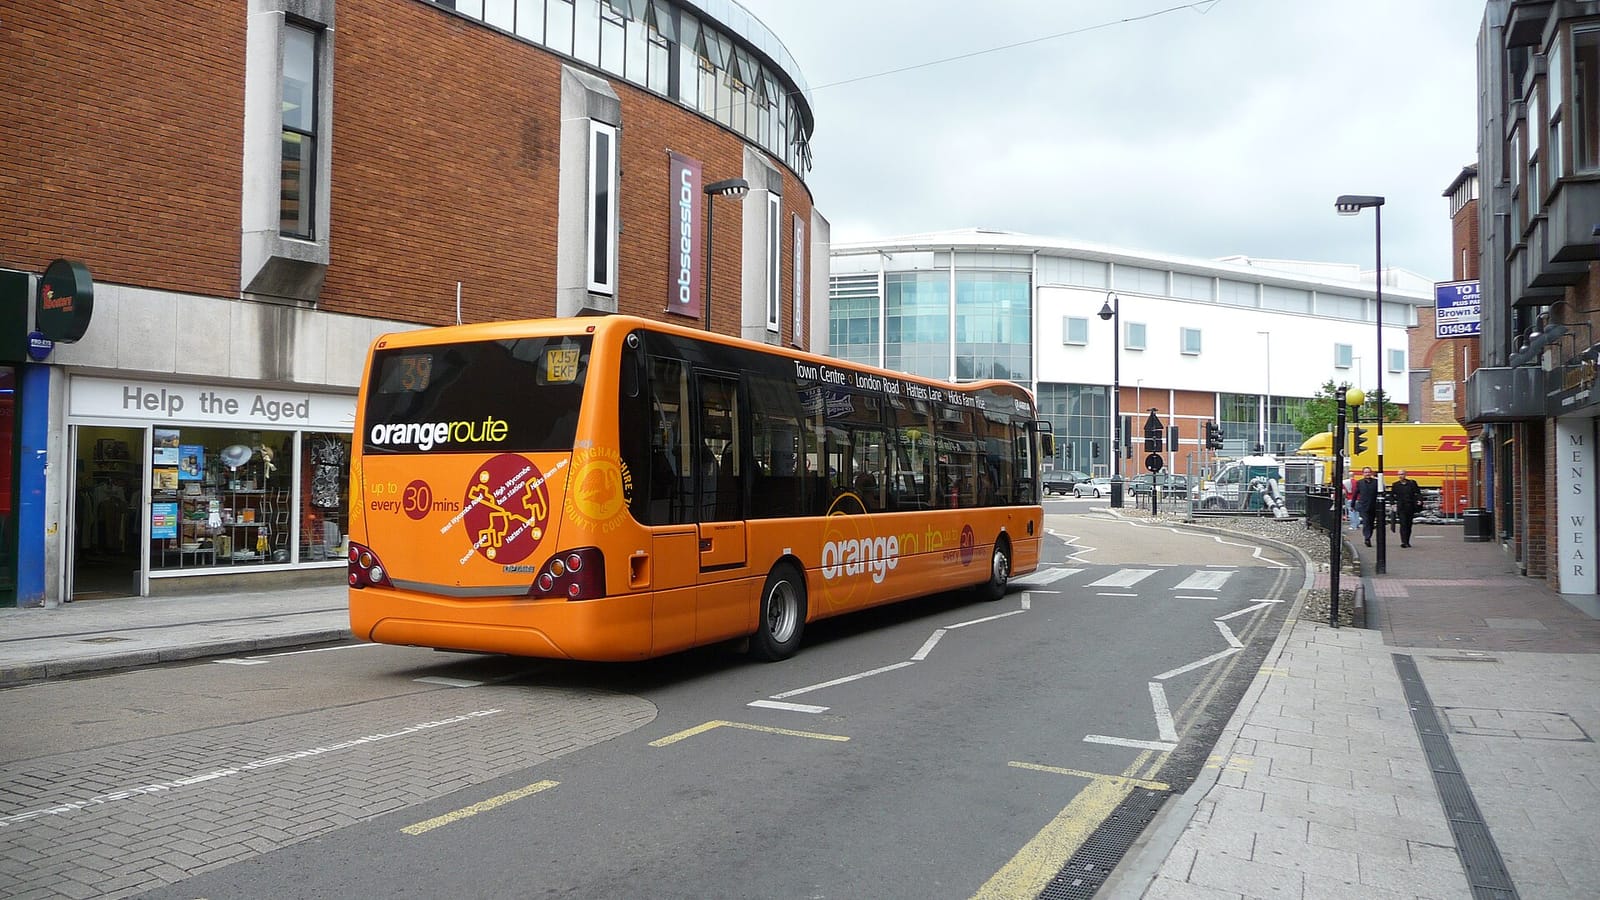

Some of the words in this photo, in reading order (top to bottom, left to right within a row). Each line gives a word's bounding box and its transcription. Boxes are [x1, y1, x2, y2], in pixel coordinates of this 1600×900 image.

[678, 168, 692, 304] obsession
[1456, 285, 1472, 294] TO
[1438, 309, 1471, 318] Brown
[1473, 306, 1480, 315] &
[1440, 323, 1472, 335] 01494
[550, 350, 577, 363] YJ57
[400, 356, 431, 391] 39
[553, 364, 574, 378] EKF
[794, 361, 817, 380] Town
[820, 365, 845, 385] Centre
[855, 373, 881, 392] London
[883, 377, 900, 395] Road
[906, 382, 927, 399] Hatters
[928, 387, 942, 402] Lane
[948, 390, 962, 405] Hicks
[962, 393, 975, 408] Farm
[123, 386, 184, 417] Help
[200, 392, 239, 415] the
[250, 394, 310, 422] Aged
[1570, 434, 1584, 495] MENS
[371, 482, 383, 495] up
[387, 481, 398, 494] to
[371, 500, 401, 514] every
[405, 487, 430, 512] 30
[432, 499, 459, 512] mins
[1570, 516, 1585, 577] WEAR
